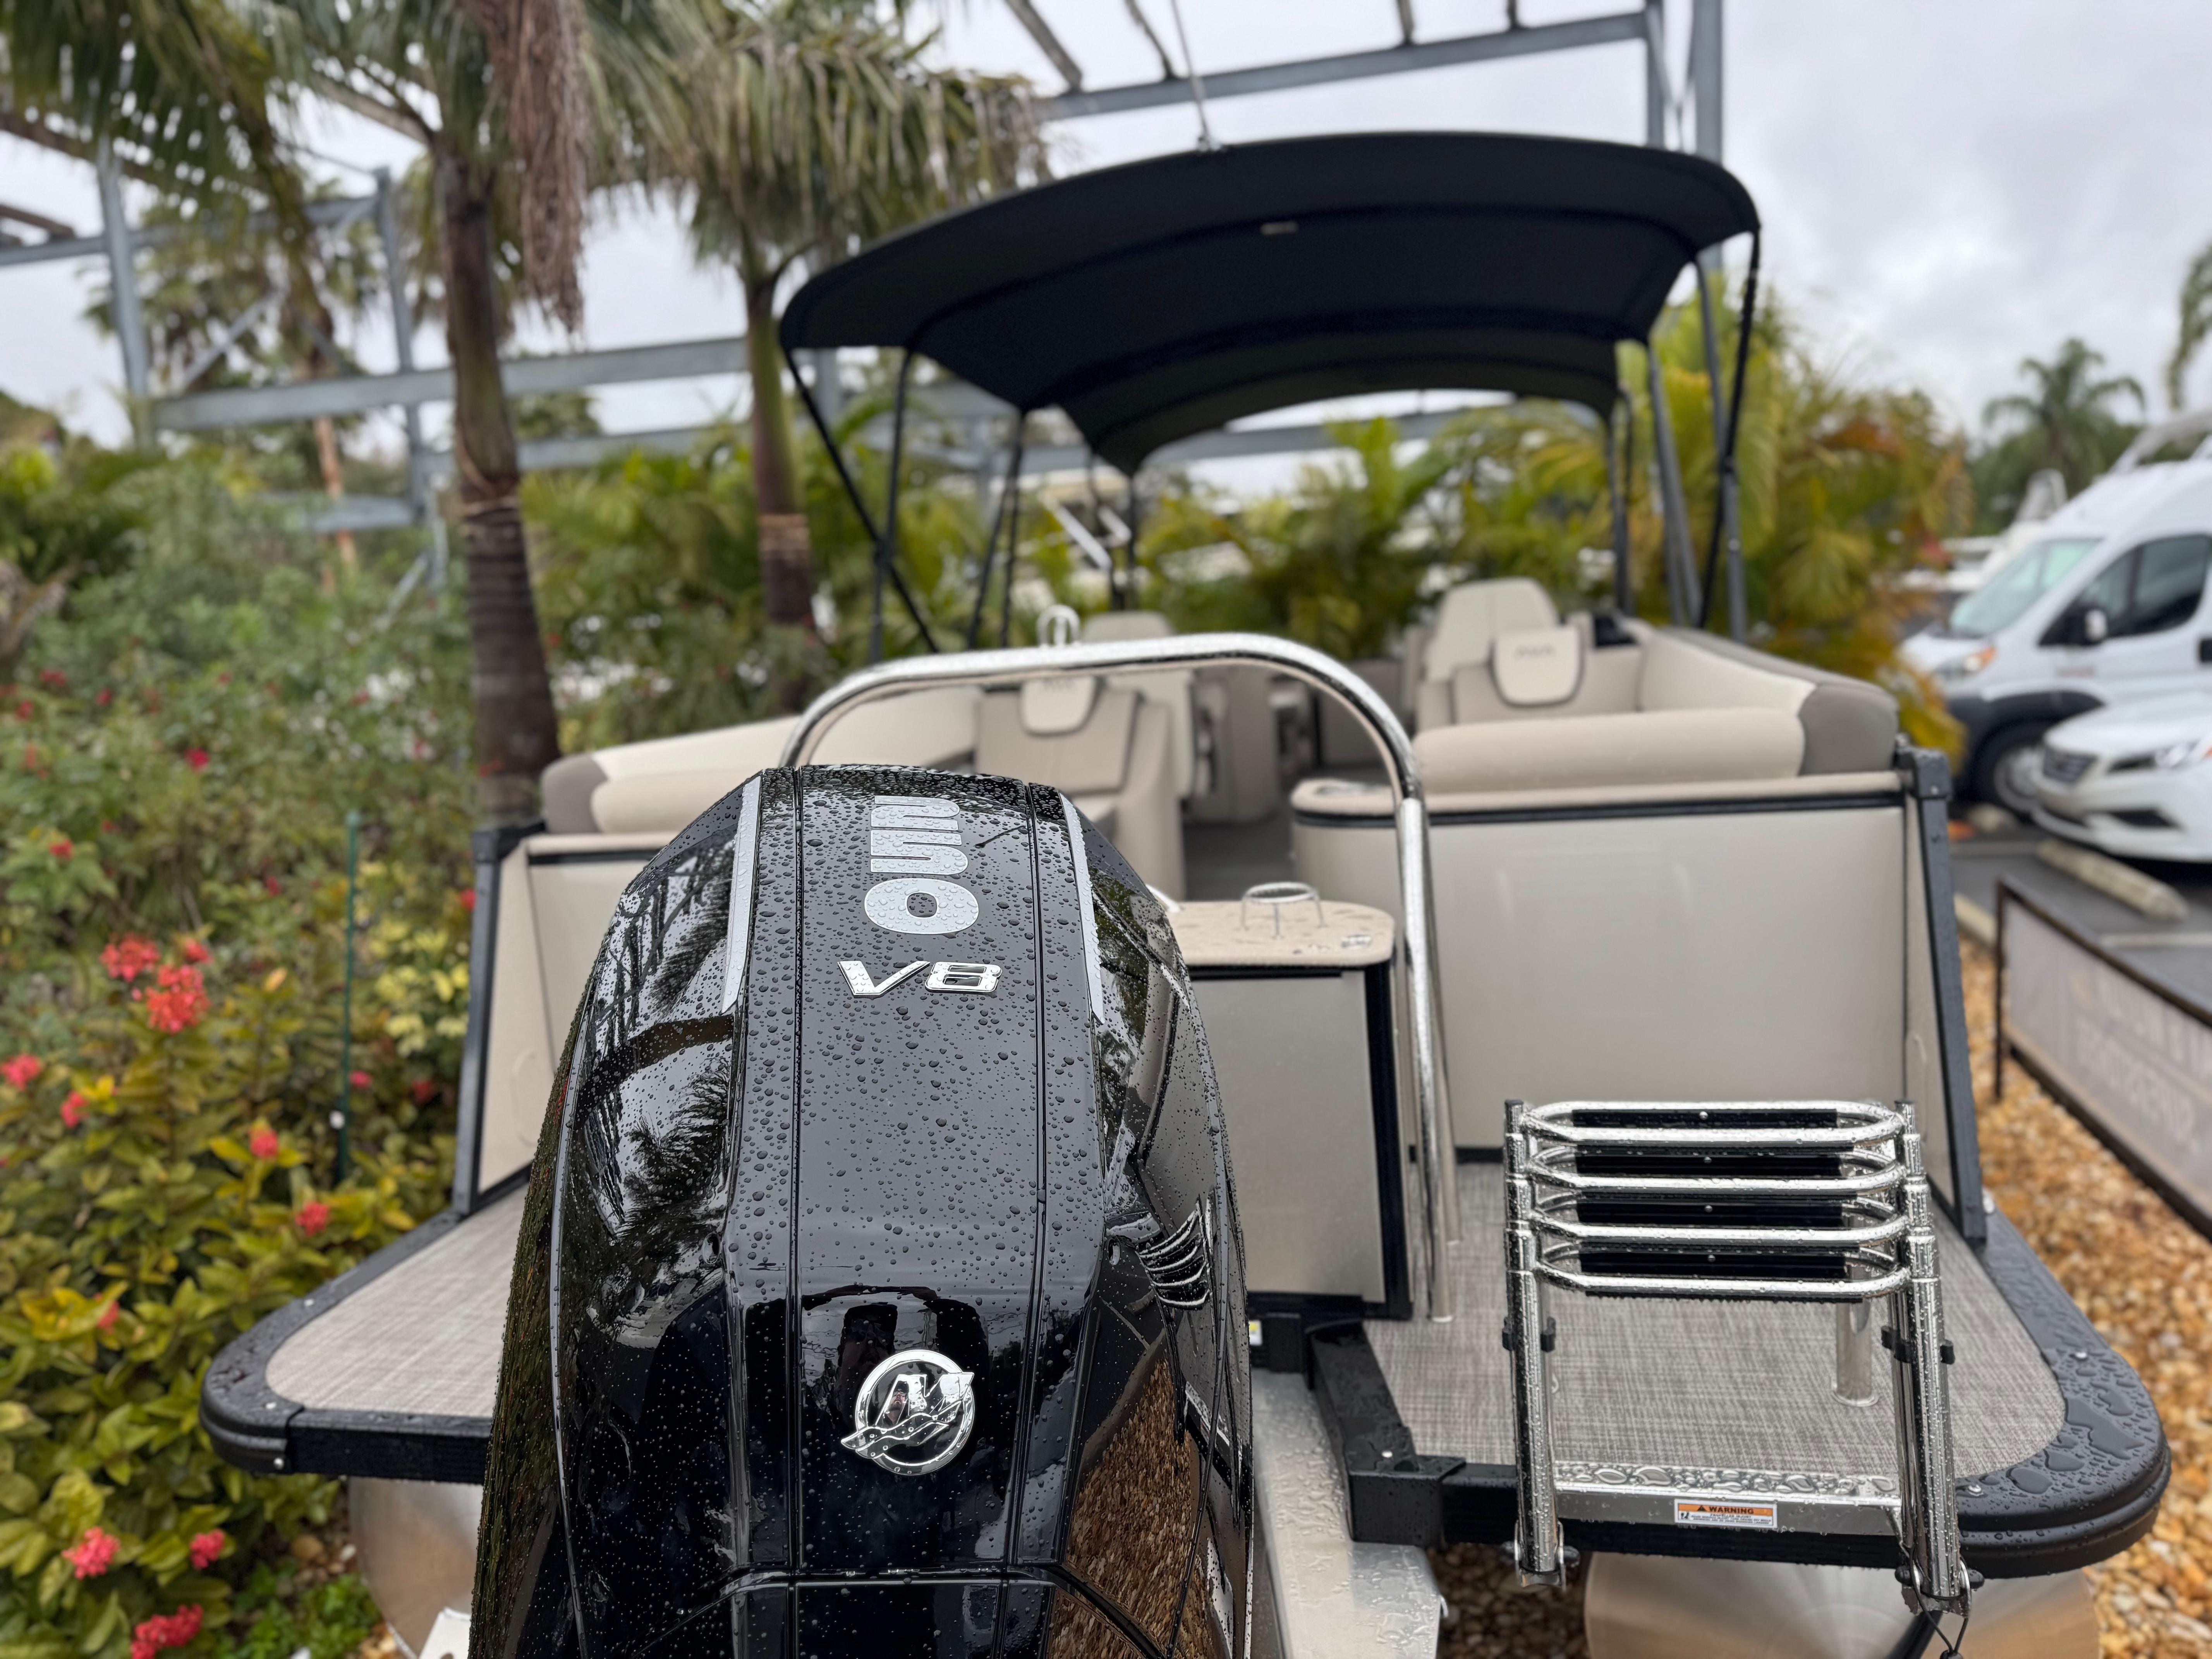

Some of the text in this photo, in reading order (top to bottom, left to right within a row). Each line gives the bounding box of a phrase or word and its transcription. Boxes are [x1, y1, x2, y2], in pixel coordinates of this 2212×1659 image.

[864, 795, 979, 934] 250
[837, 960, 1002, 996] V8
[1709, 1506, 1754, 1515] WARNING
